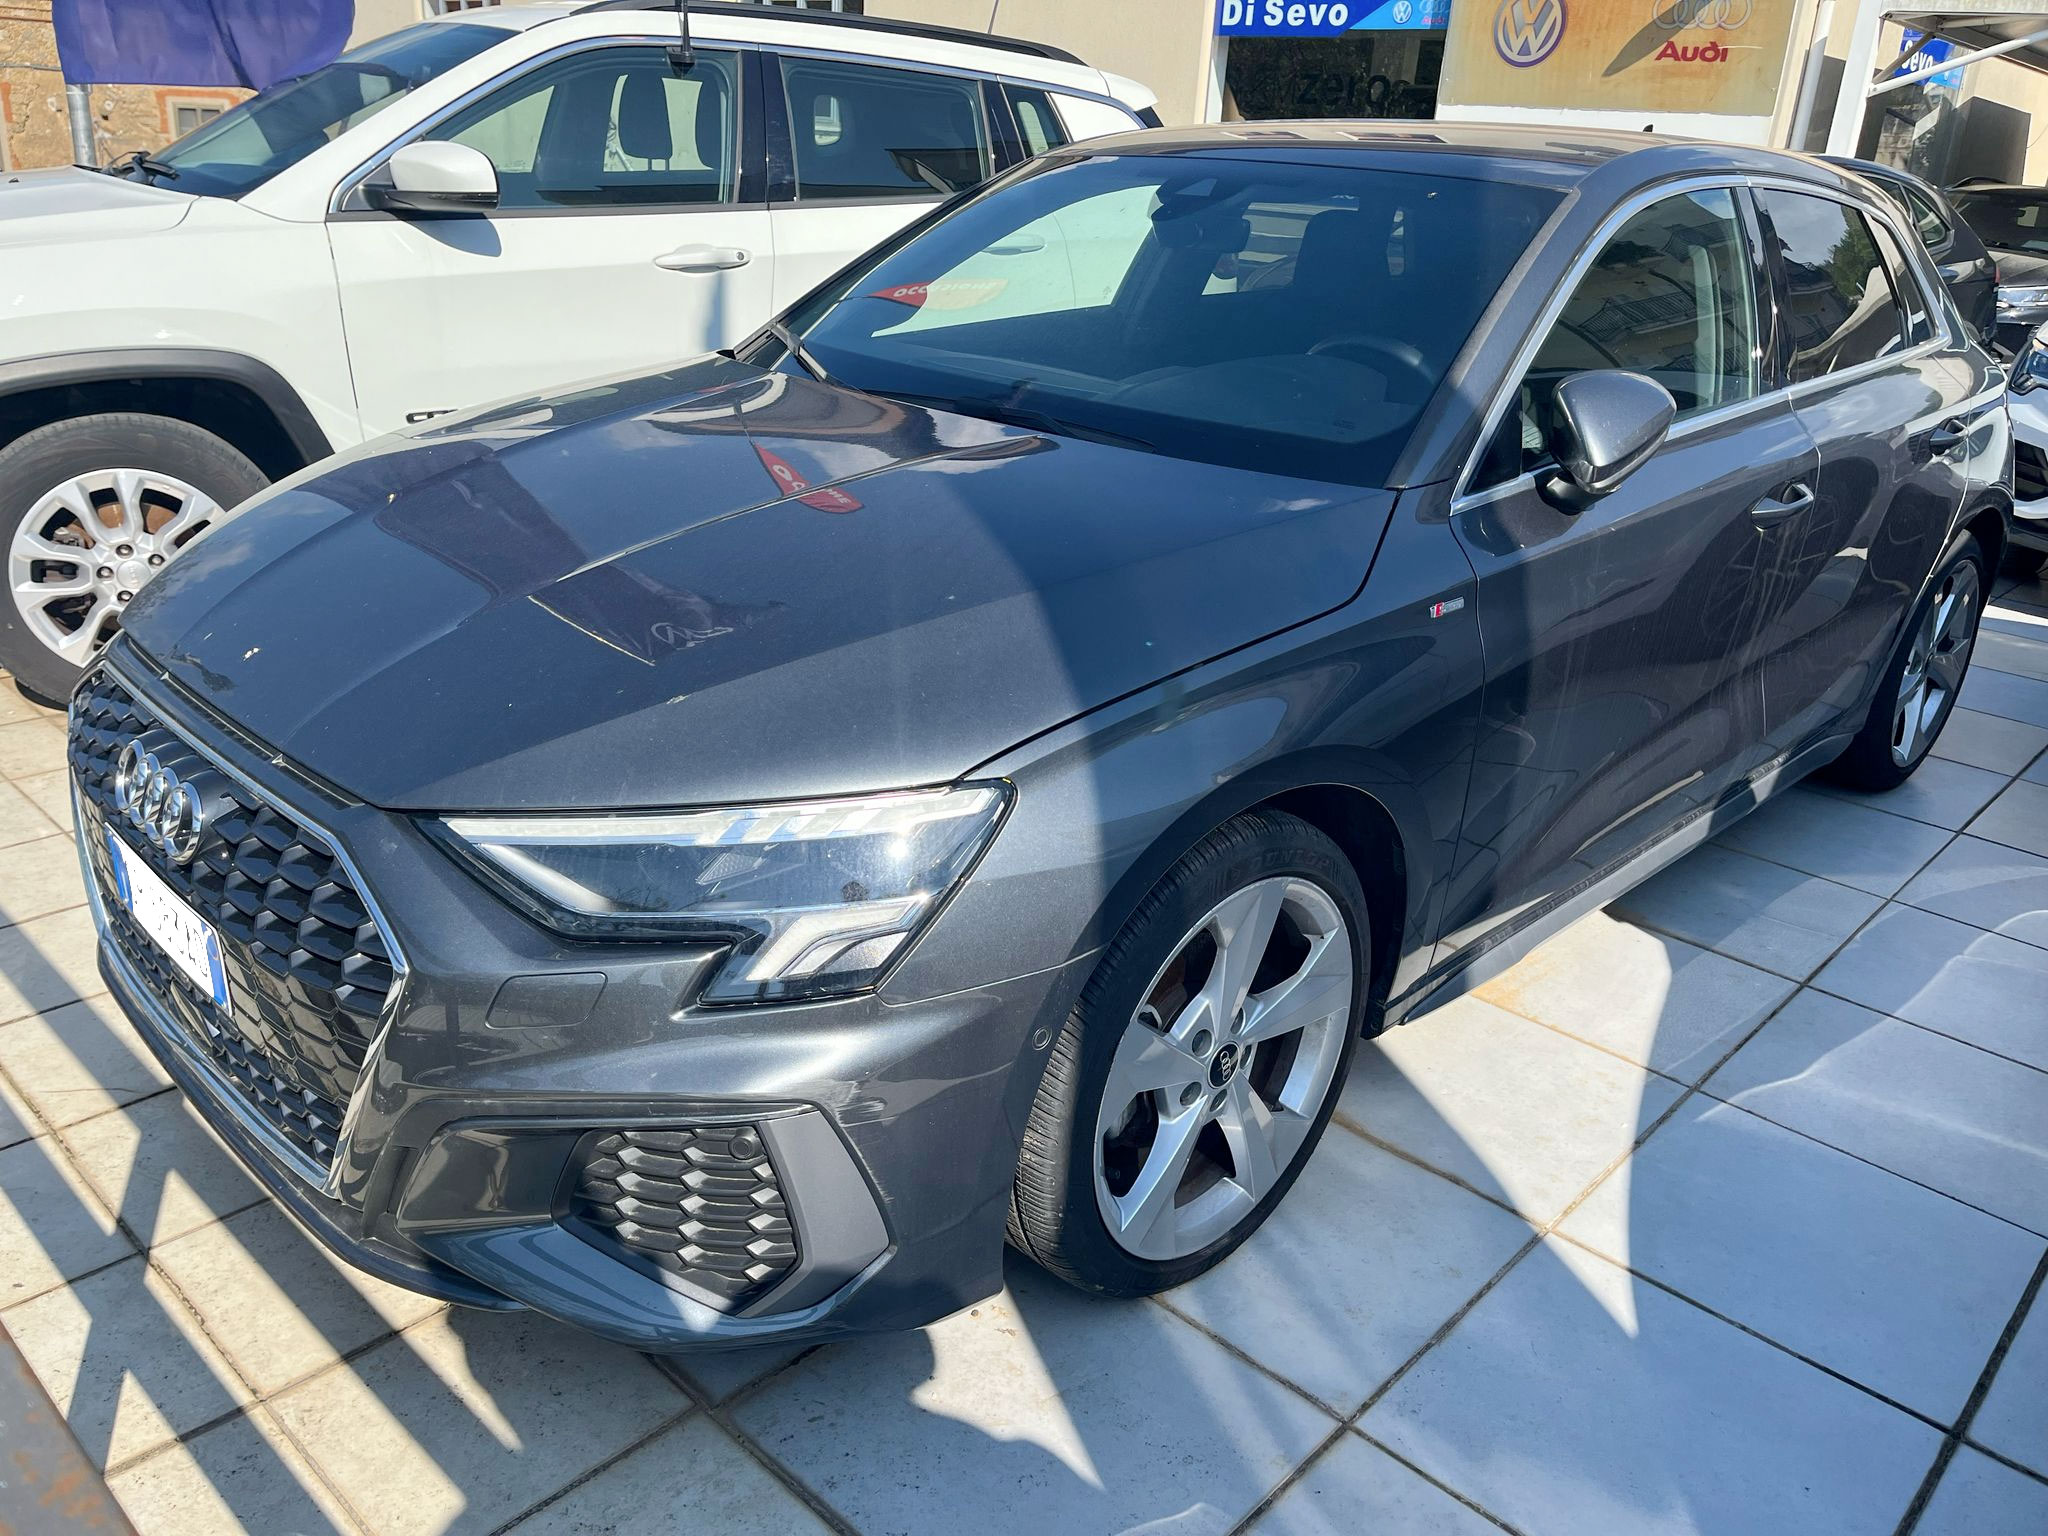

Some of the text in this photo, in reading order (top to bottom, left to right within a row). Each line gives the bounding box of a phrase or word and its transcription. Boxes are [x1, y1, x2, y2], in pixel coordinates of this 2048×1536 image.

[1221, 0, 1349, 27] Di Sevo
[1655, 40, 1729, 63] Audi
